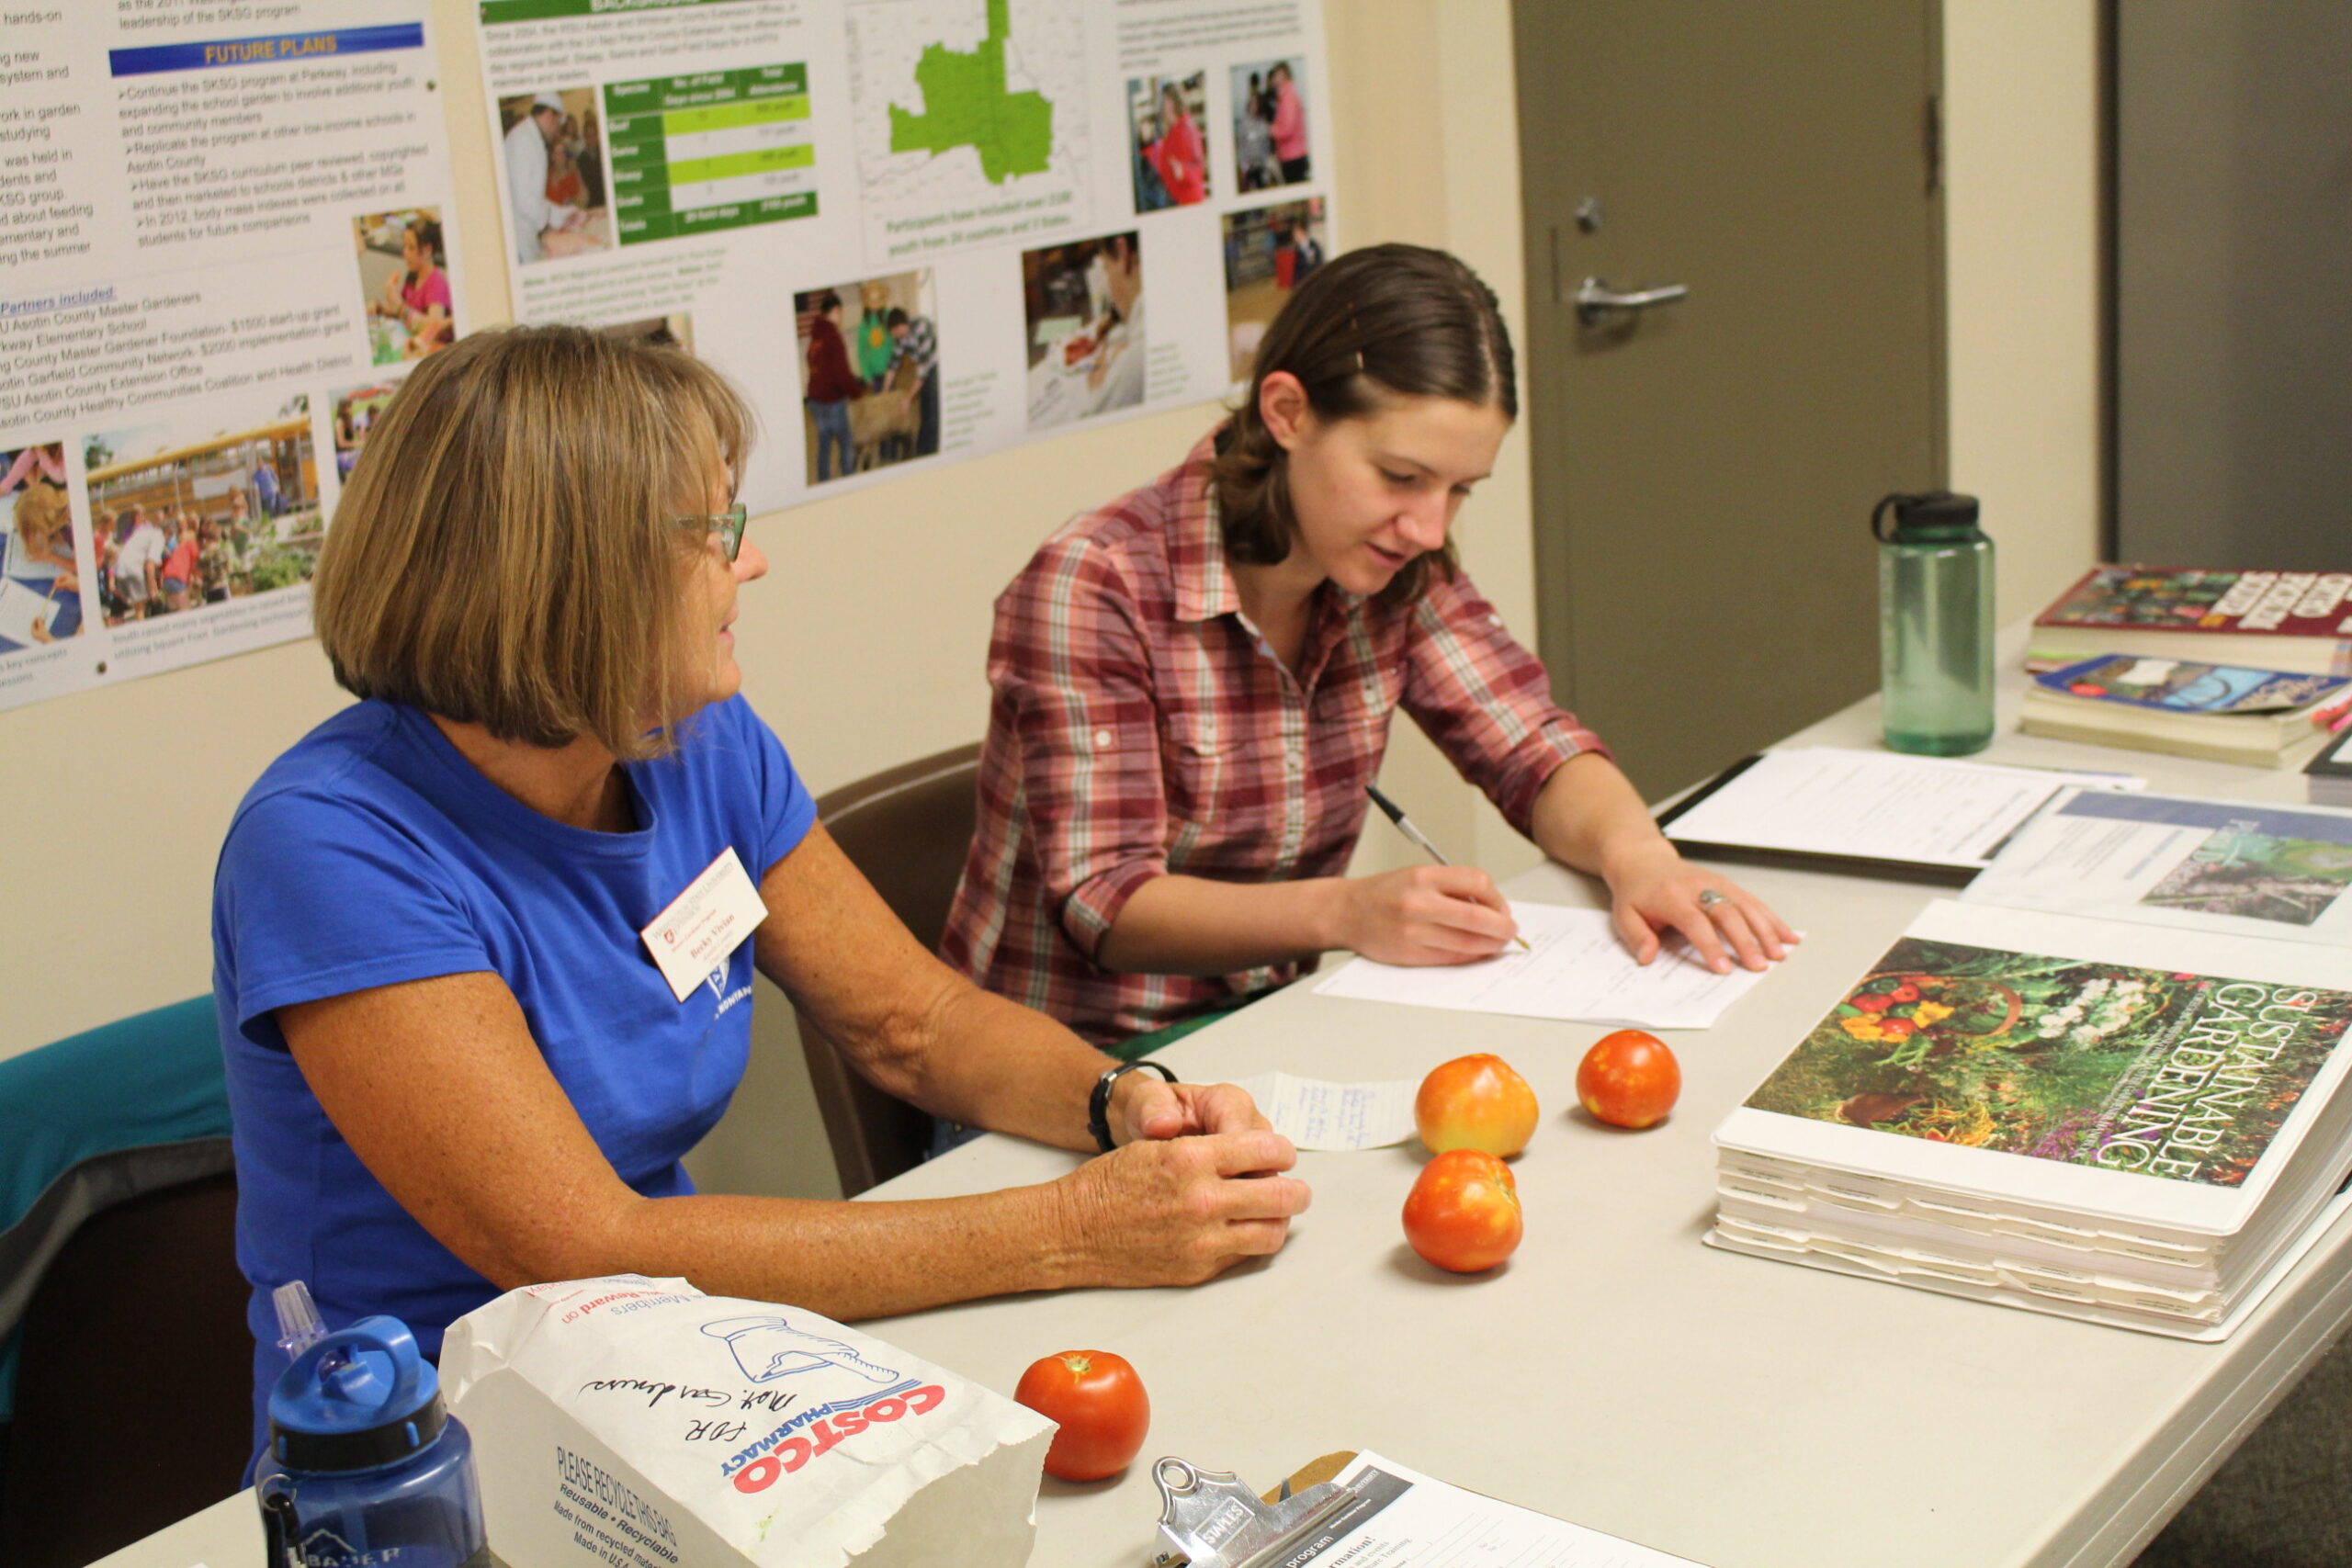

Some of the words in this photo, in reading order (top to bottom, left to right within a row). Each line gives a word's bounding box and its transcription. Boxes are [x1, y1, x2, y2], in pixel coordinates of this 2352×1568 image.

[4, 9, 62, 25] hands-on
[119, 15, 179, 29] leadership
[183, 10, 195, 25] of
[198, 11, 214, 24] the
[256, 5, 301, 19] program
[15, 51, 40, 63] new
[205, 39, 275, 64] FUTURE
[280, 34, 337, 55] PLANS
[0, 69, 43, 86] system
[46, 64, 70, 80] and
[127, 84, 179, 99] Continue
[182, 81, 198, 95] the
[241, 73, 286, 89] program
[0, 107, 20, 122] ork
[24, 106, 35, 118] in
[39, 102, 81, 121] garden
[119, 102, 178, 119] expanding
[182, 99, 199, 113] the
[202, 95, 238, 110] school
[242, 92, 279, 108] garden
[0, 125, 51, 142] studying
[122, 123, 143, 138] and
[147, 118, 208, 135] community
[210, 111, 262, 127] members
[135, 139, 187, 154] Replicate
[190, 135, 209, 149] the
[211, 130, 257, 147] program
[274, 125, 300, 140] other
[6, 153, 29, 166] was
[32, 149, 58, 164] held
[62, 147, 73, 163] in
[166, 153, 206, 171] County
[35, 169, 57, 184] and
[140, 177, 170, 191] Have
[173, 174, 191, 187] the
[12, 209, 46, 225] about
[49, 202, 94, 219] feeding
[132, 196, 154, 211] and
[157, 193, 182, 208] then
[194, 207, 222, 222] body
[57, 223, 79, 237] and
[139, 229, 187, 248] students
[188, 226, 204, 241] for
[207, 222, 239, 238] future
[20, 248, 40, 262] the
[43, 242, 91, 260] summer
[0, 298, 55, 315] Partners
[14, 316, 51, 333] Asotin
[53, 309, 96, 326] County
[99, 300, 140, 318] Master
[141, 292, 202, 313] Gardeners
[37, 326, 104, 347] Elementary
[107, 317, 147, 335] School
[15, 352, 58, 369] County
[61, 344, 101, 362] Master
[105, 335, 159, 355] Gardener
[28, 367, 75, 386] Garfield
[79, 355, 144, 378] Community
[25, 389, 62, 405] Asotin
[65, 381, 108, 399] County
[110, 371, 167, 390] Extension
[169, 364, 203, 381] Office
[33, 404, 77, 423] County
[80, 397, 125, 413] Healthy
[127, 382, 202, 406] Communities
[256, 367, 277, 382] and
[2097, 983, 2267, 1169] GARDENING
[2149, 988, 2318, 1178] SUSTAINABLE
[579, 1291, 640, 1315] Reward
[610, 1292, 692, 1316] Members
[560, 1310, 580, 1325] on
[684, 1418, 748, 1442] FOR
[721, 1402, 834, 1477] PHARMACY
[733, 1384, 945, 1495] COSTCO
[557, 1446, 594, 1494] PLEASE
[594, 1465, 637, 1520] RECYCLE
[633, 1494, 658, 1534] THIS
[654, 1509, 677, 1548] BAG
[553, 1499, 574, 1521] Made
[573, 1514, 595, 1535] from
[595, 1529, 635, 1558] recycled
[560, 1483, 609, 1519] Reusable
[616, 1518, 679, 1564] Recyclable
[573, 1530, 598, 1554] Made
[598, 1546, 609, 1560] in
[1284, 1534, 1335, 1568] program
